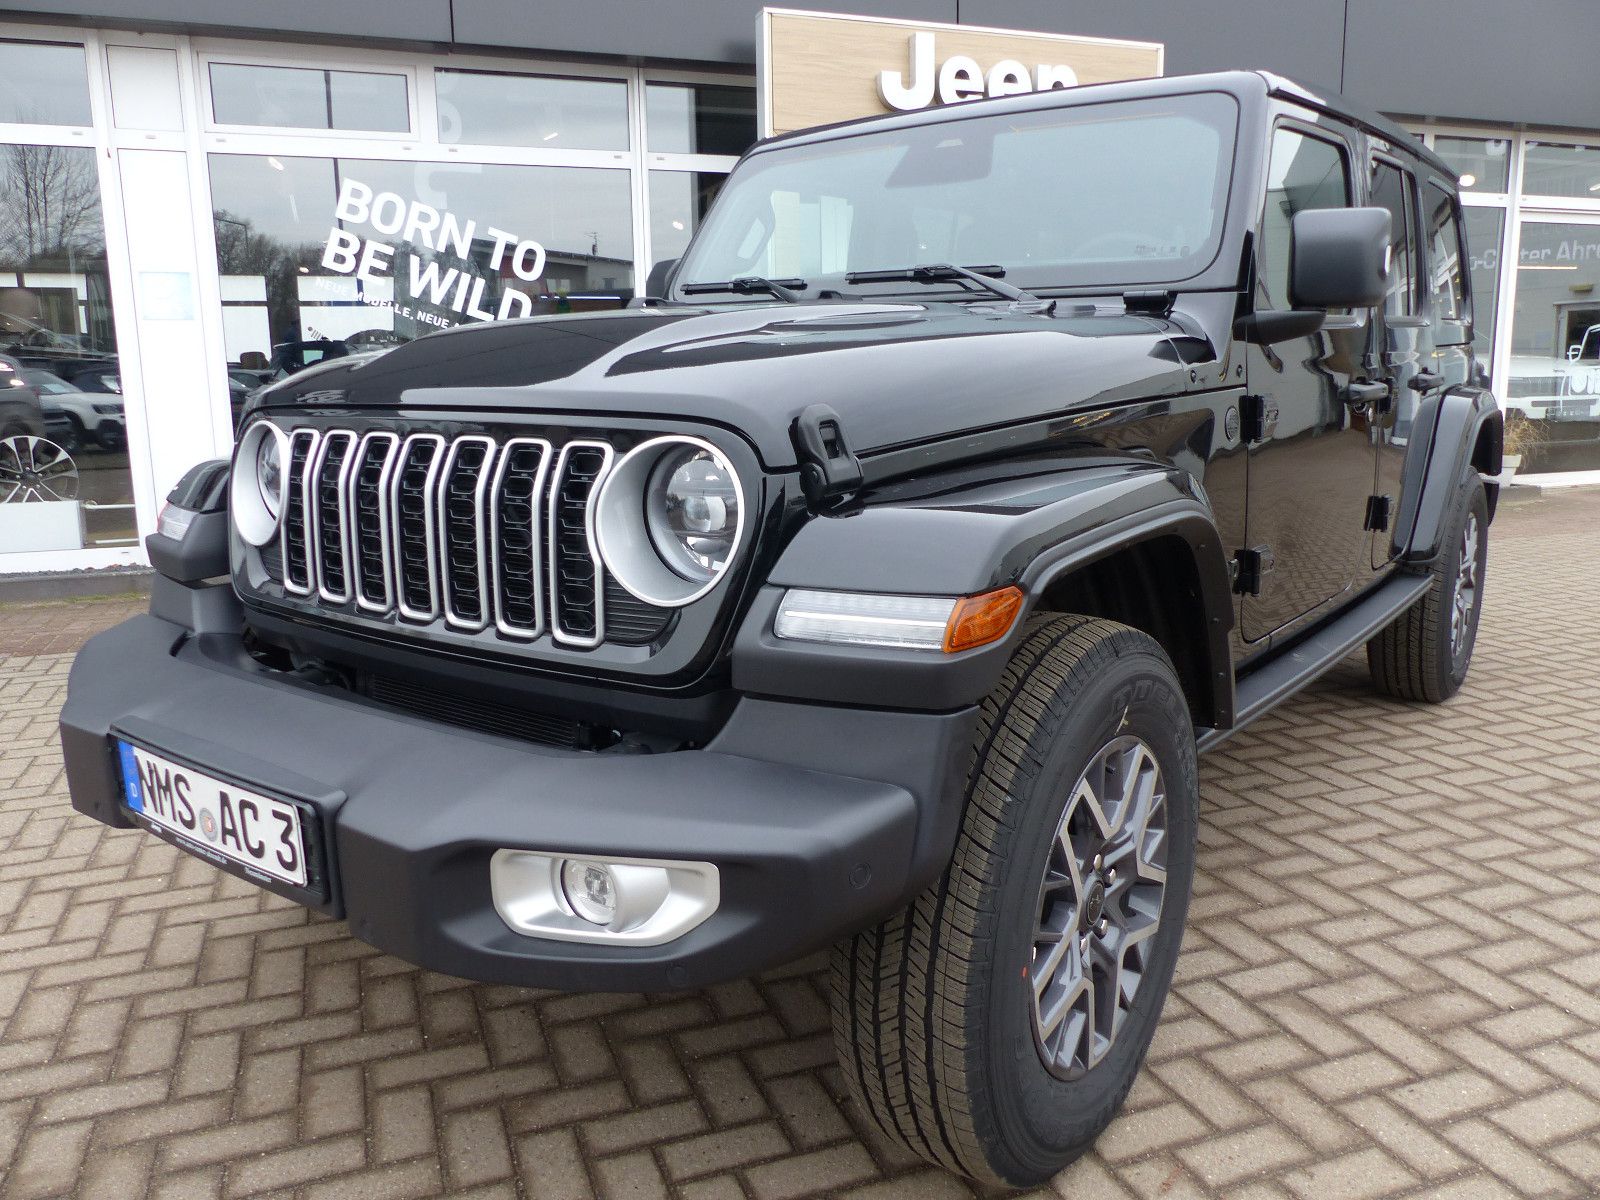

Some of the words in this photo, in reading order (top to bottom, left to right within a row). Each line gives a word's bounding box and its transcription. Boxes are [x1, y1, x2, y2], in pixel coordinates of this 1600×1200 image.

[321, 227, 395, 286] BE
[409, 254, 533, 322] WILD
[335, 177, 476, 261] BORN
[488, 226, 546, 282] TO
[315, 277, 348, 296] NEUE
[416, 310, 450, 329] NEUE
[135, 755, 196, 830] NMS
[219, 790, 265, 859] AC
[271, 809, 298, 872] 3
